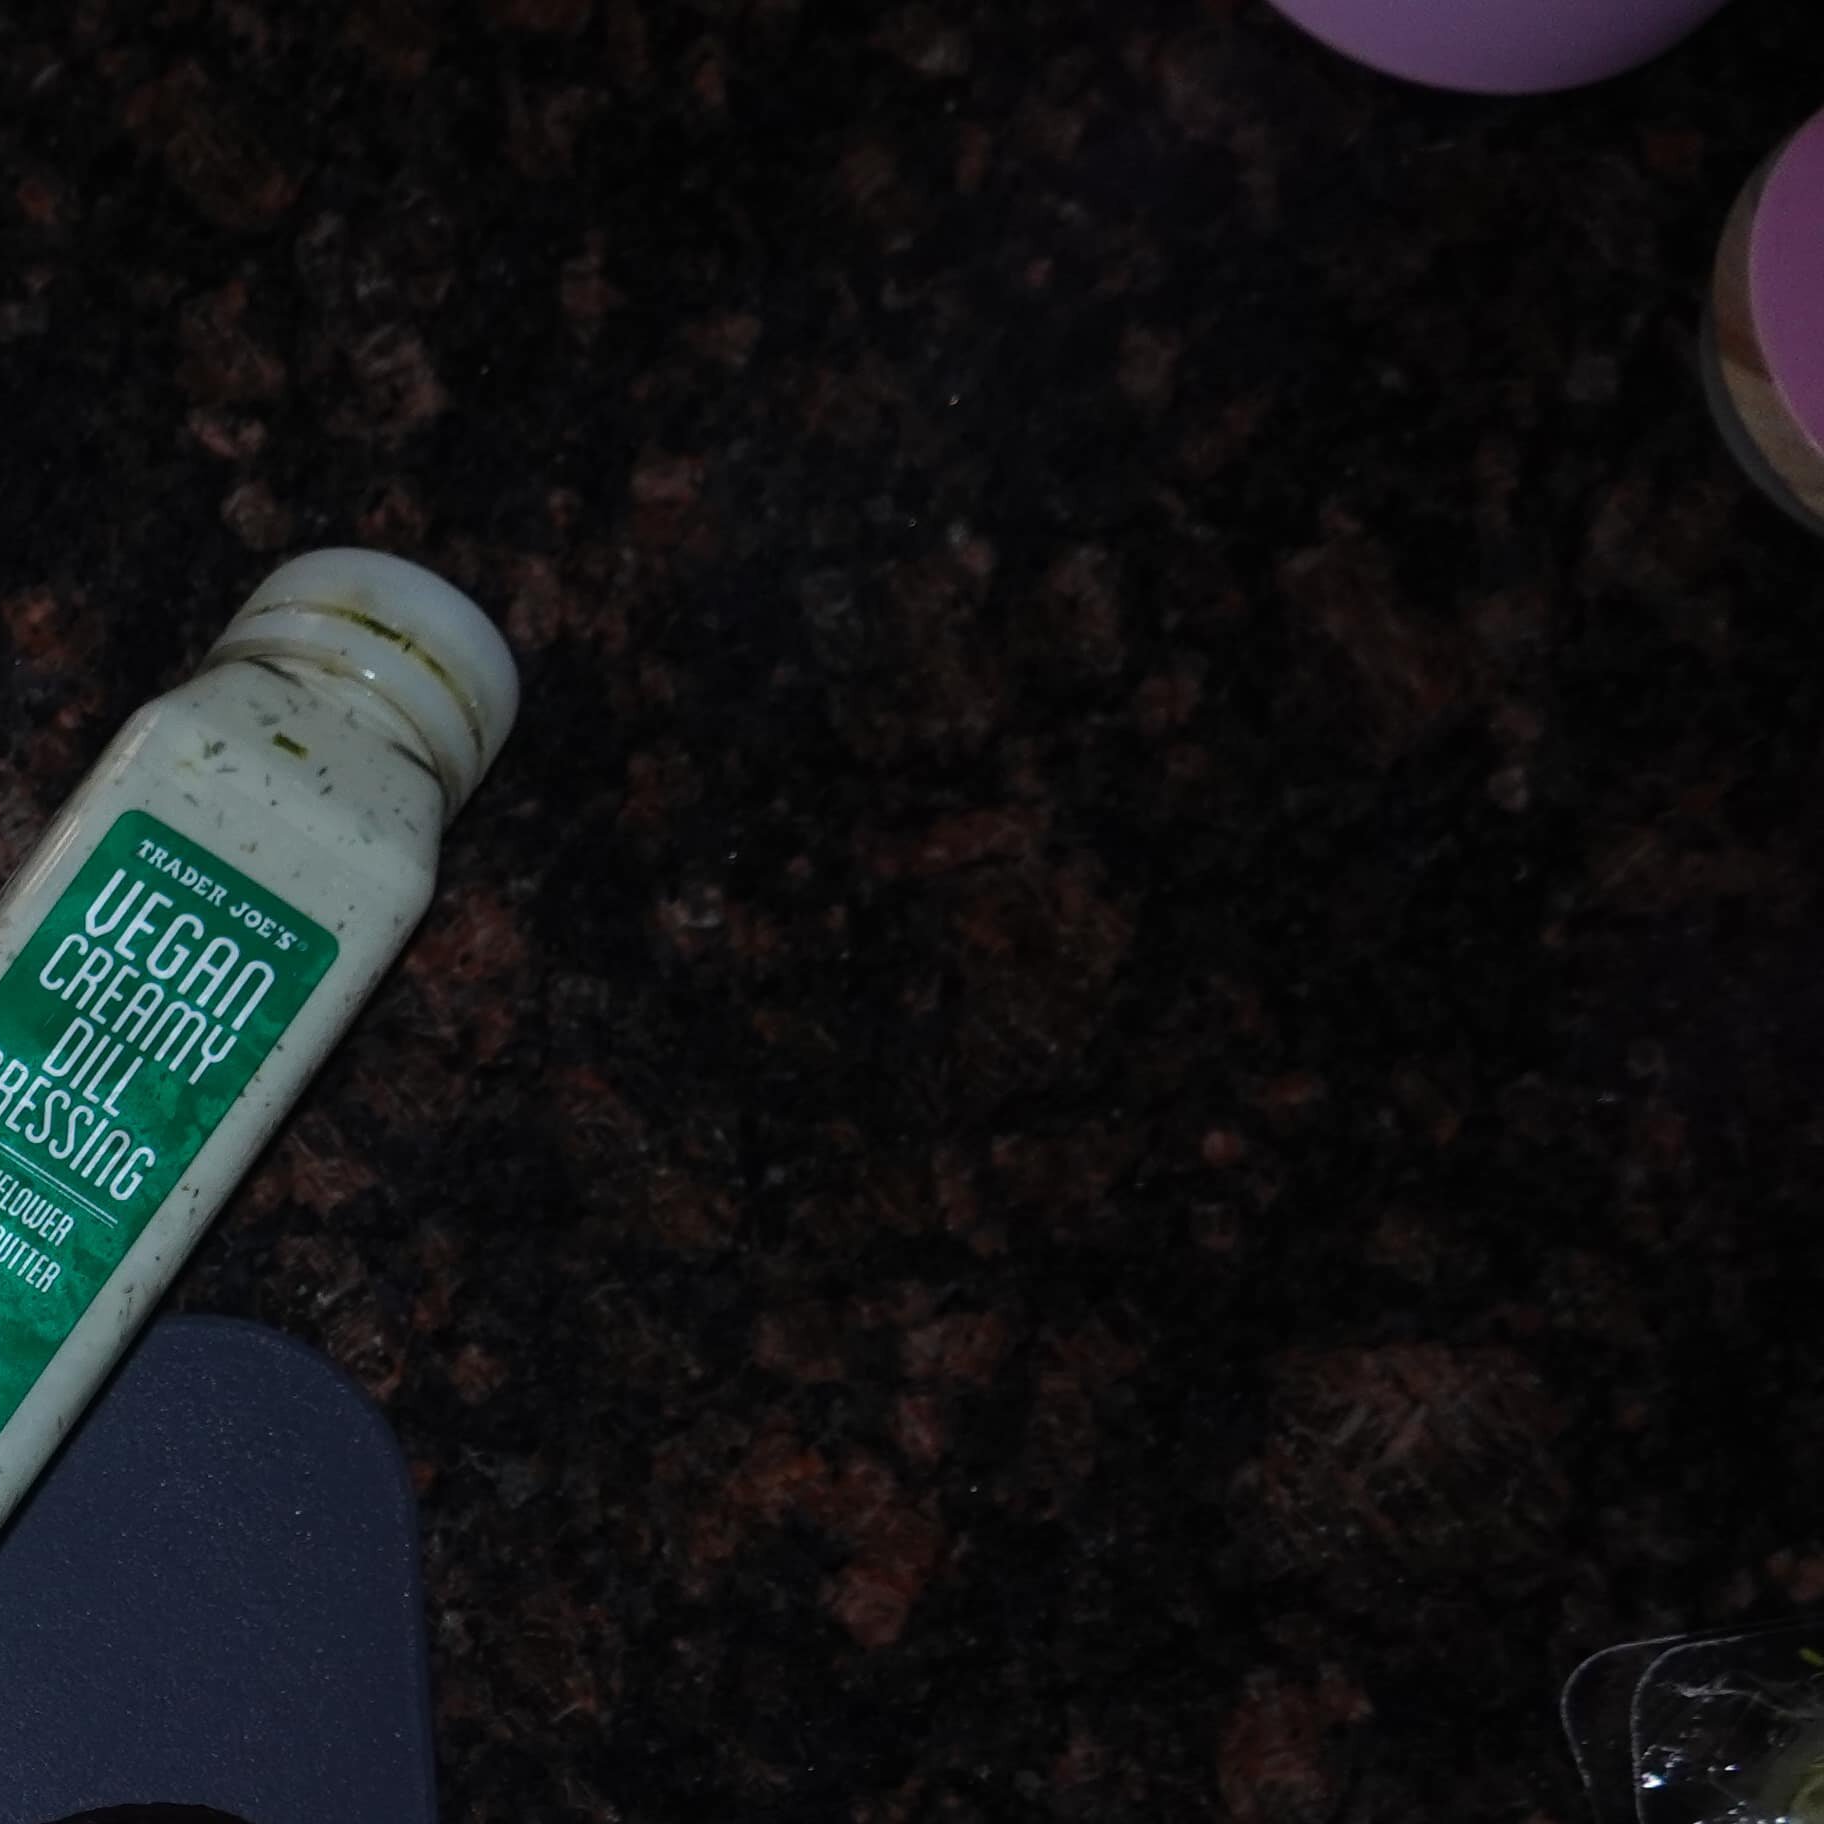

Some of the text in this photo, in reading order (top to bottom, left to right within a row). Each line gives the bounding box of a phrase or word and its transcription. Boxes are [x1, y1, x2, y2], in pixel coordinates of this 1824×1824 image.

[135, 838, 232, 908] TRADER
[38, 933, 238, 1086] CREAMY
[84, 868, 275, 1032] VEGAN
[41, 1017, 145, 1118] DILL
